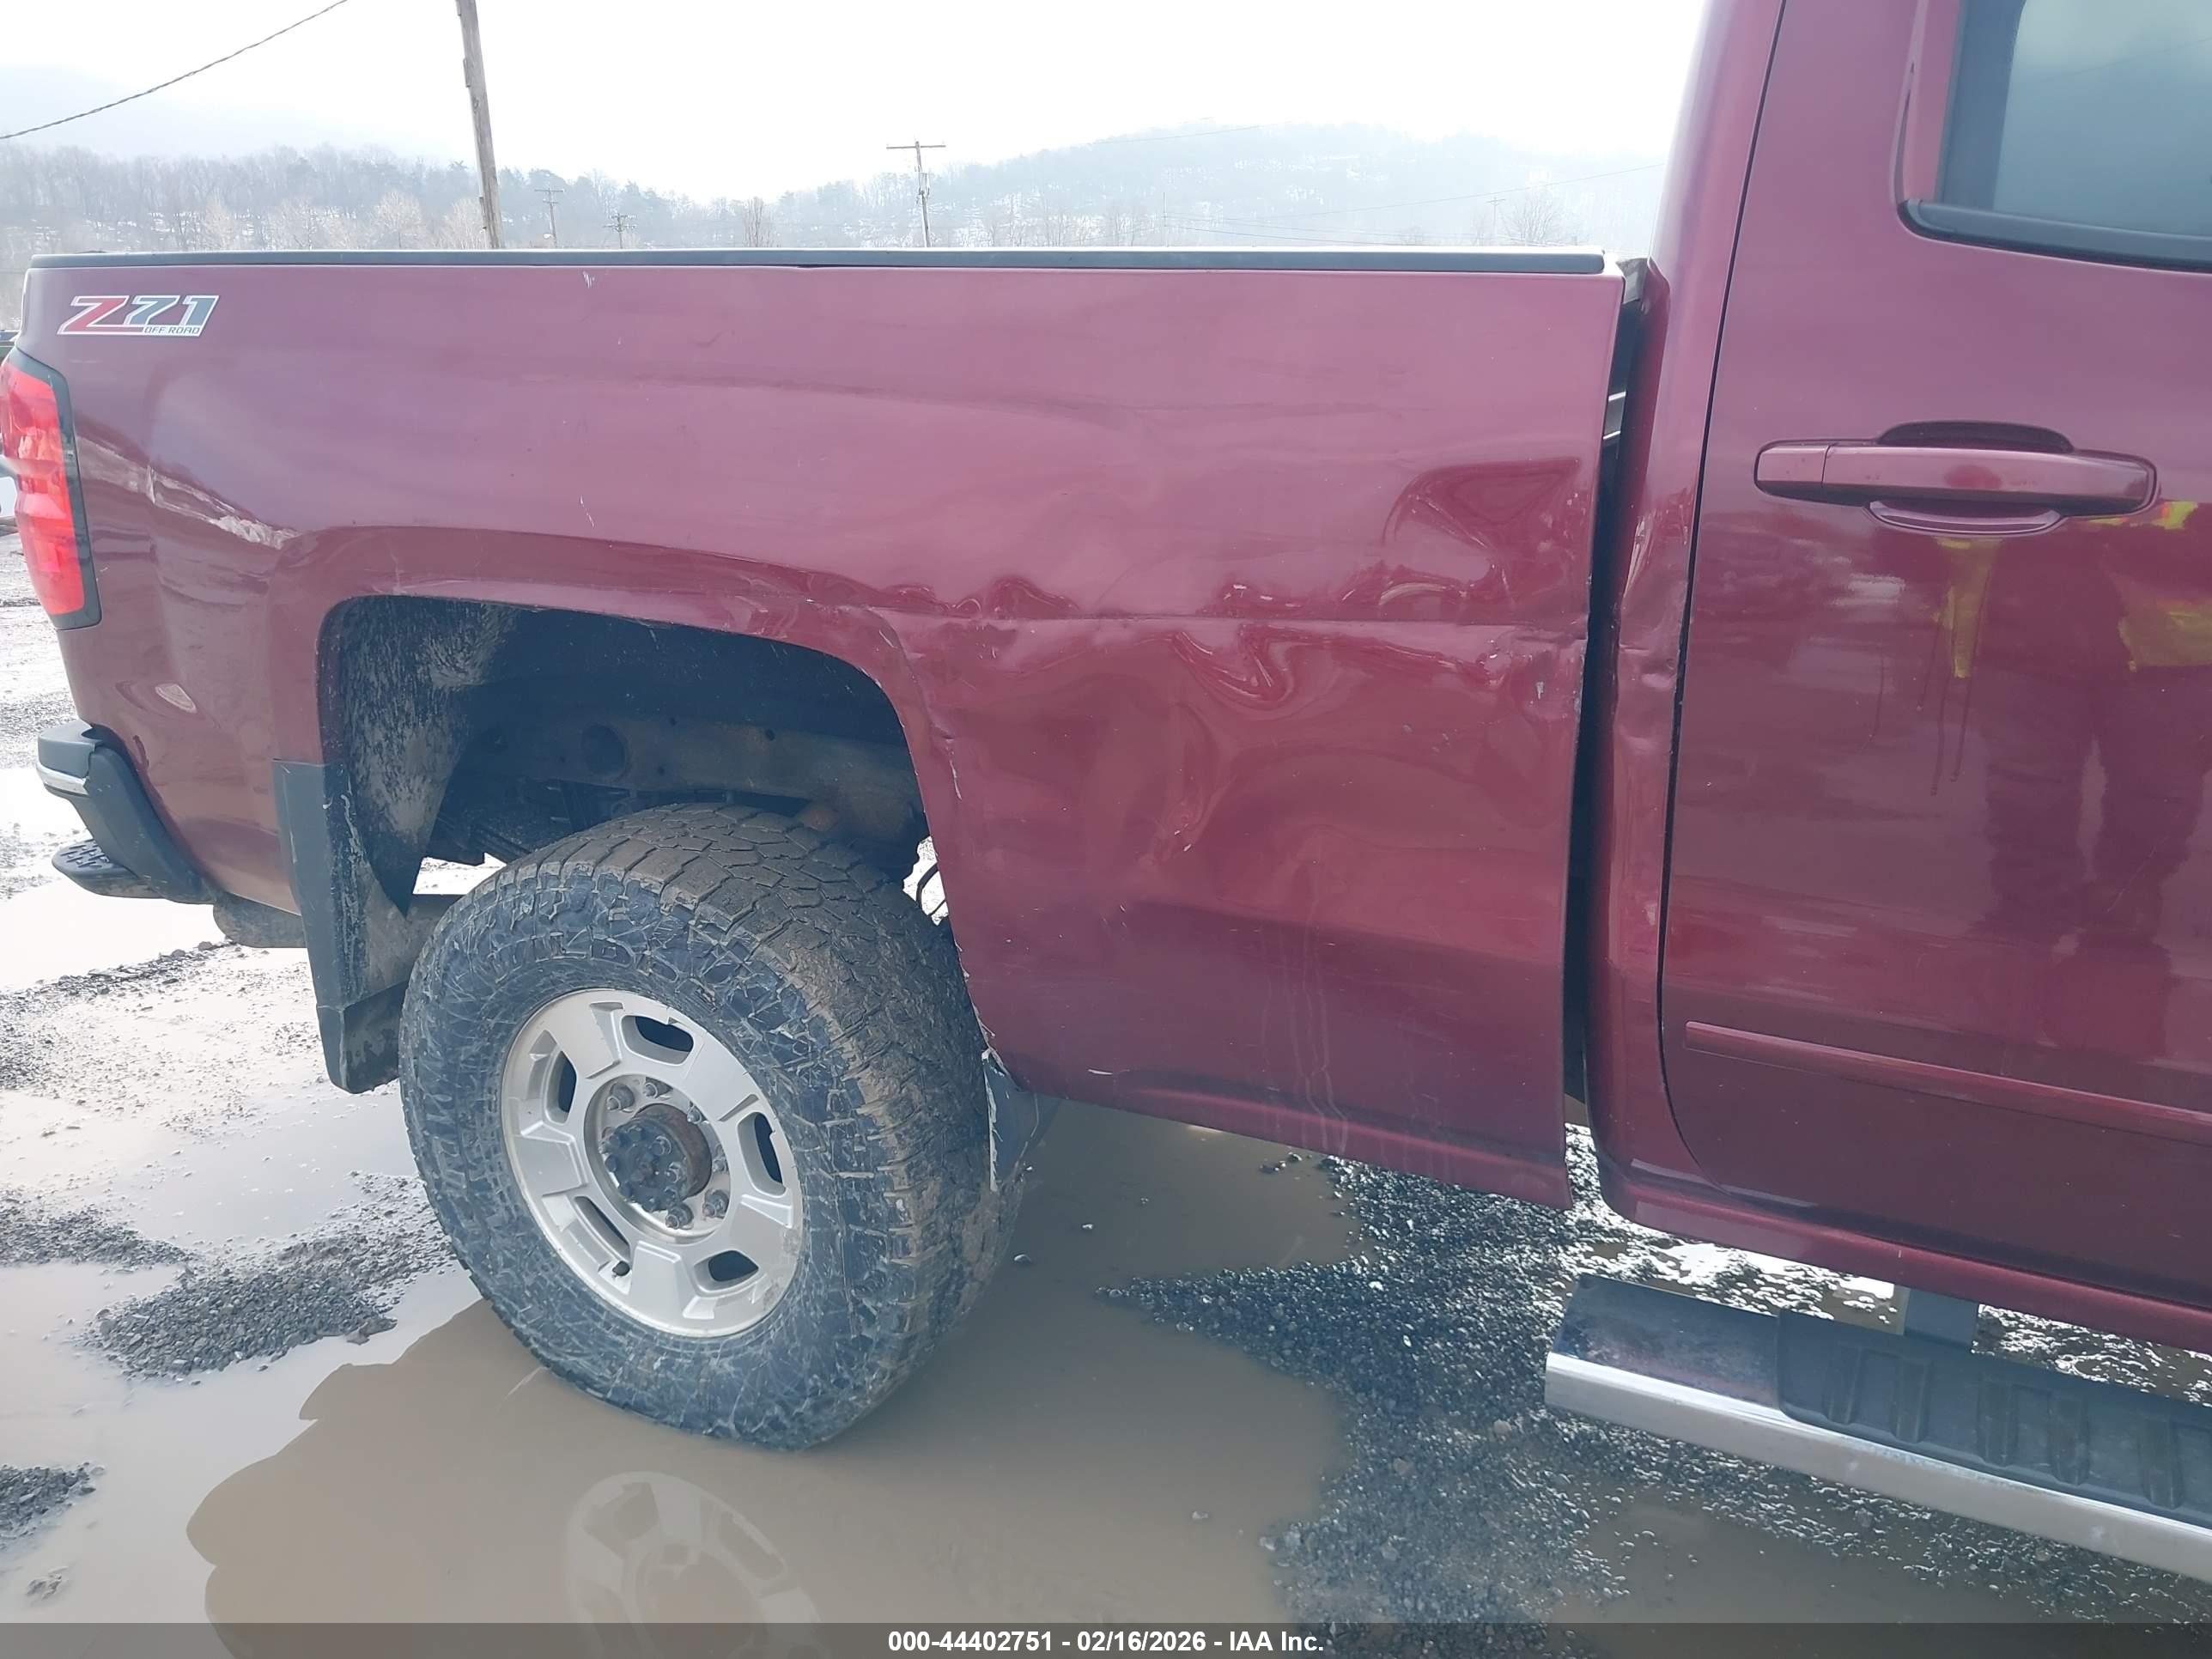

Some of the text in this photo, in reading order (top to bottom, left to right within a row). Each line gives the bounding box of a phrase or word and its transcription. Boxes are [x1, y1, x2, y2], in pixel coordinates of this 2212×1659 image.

[57, 295, 220, 337] Z71
[143, 326, 200, 335] OFF ROAD
